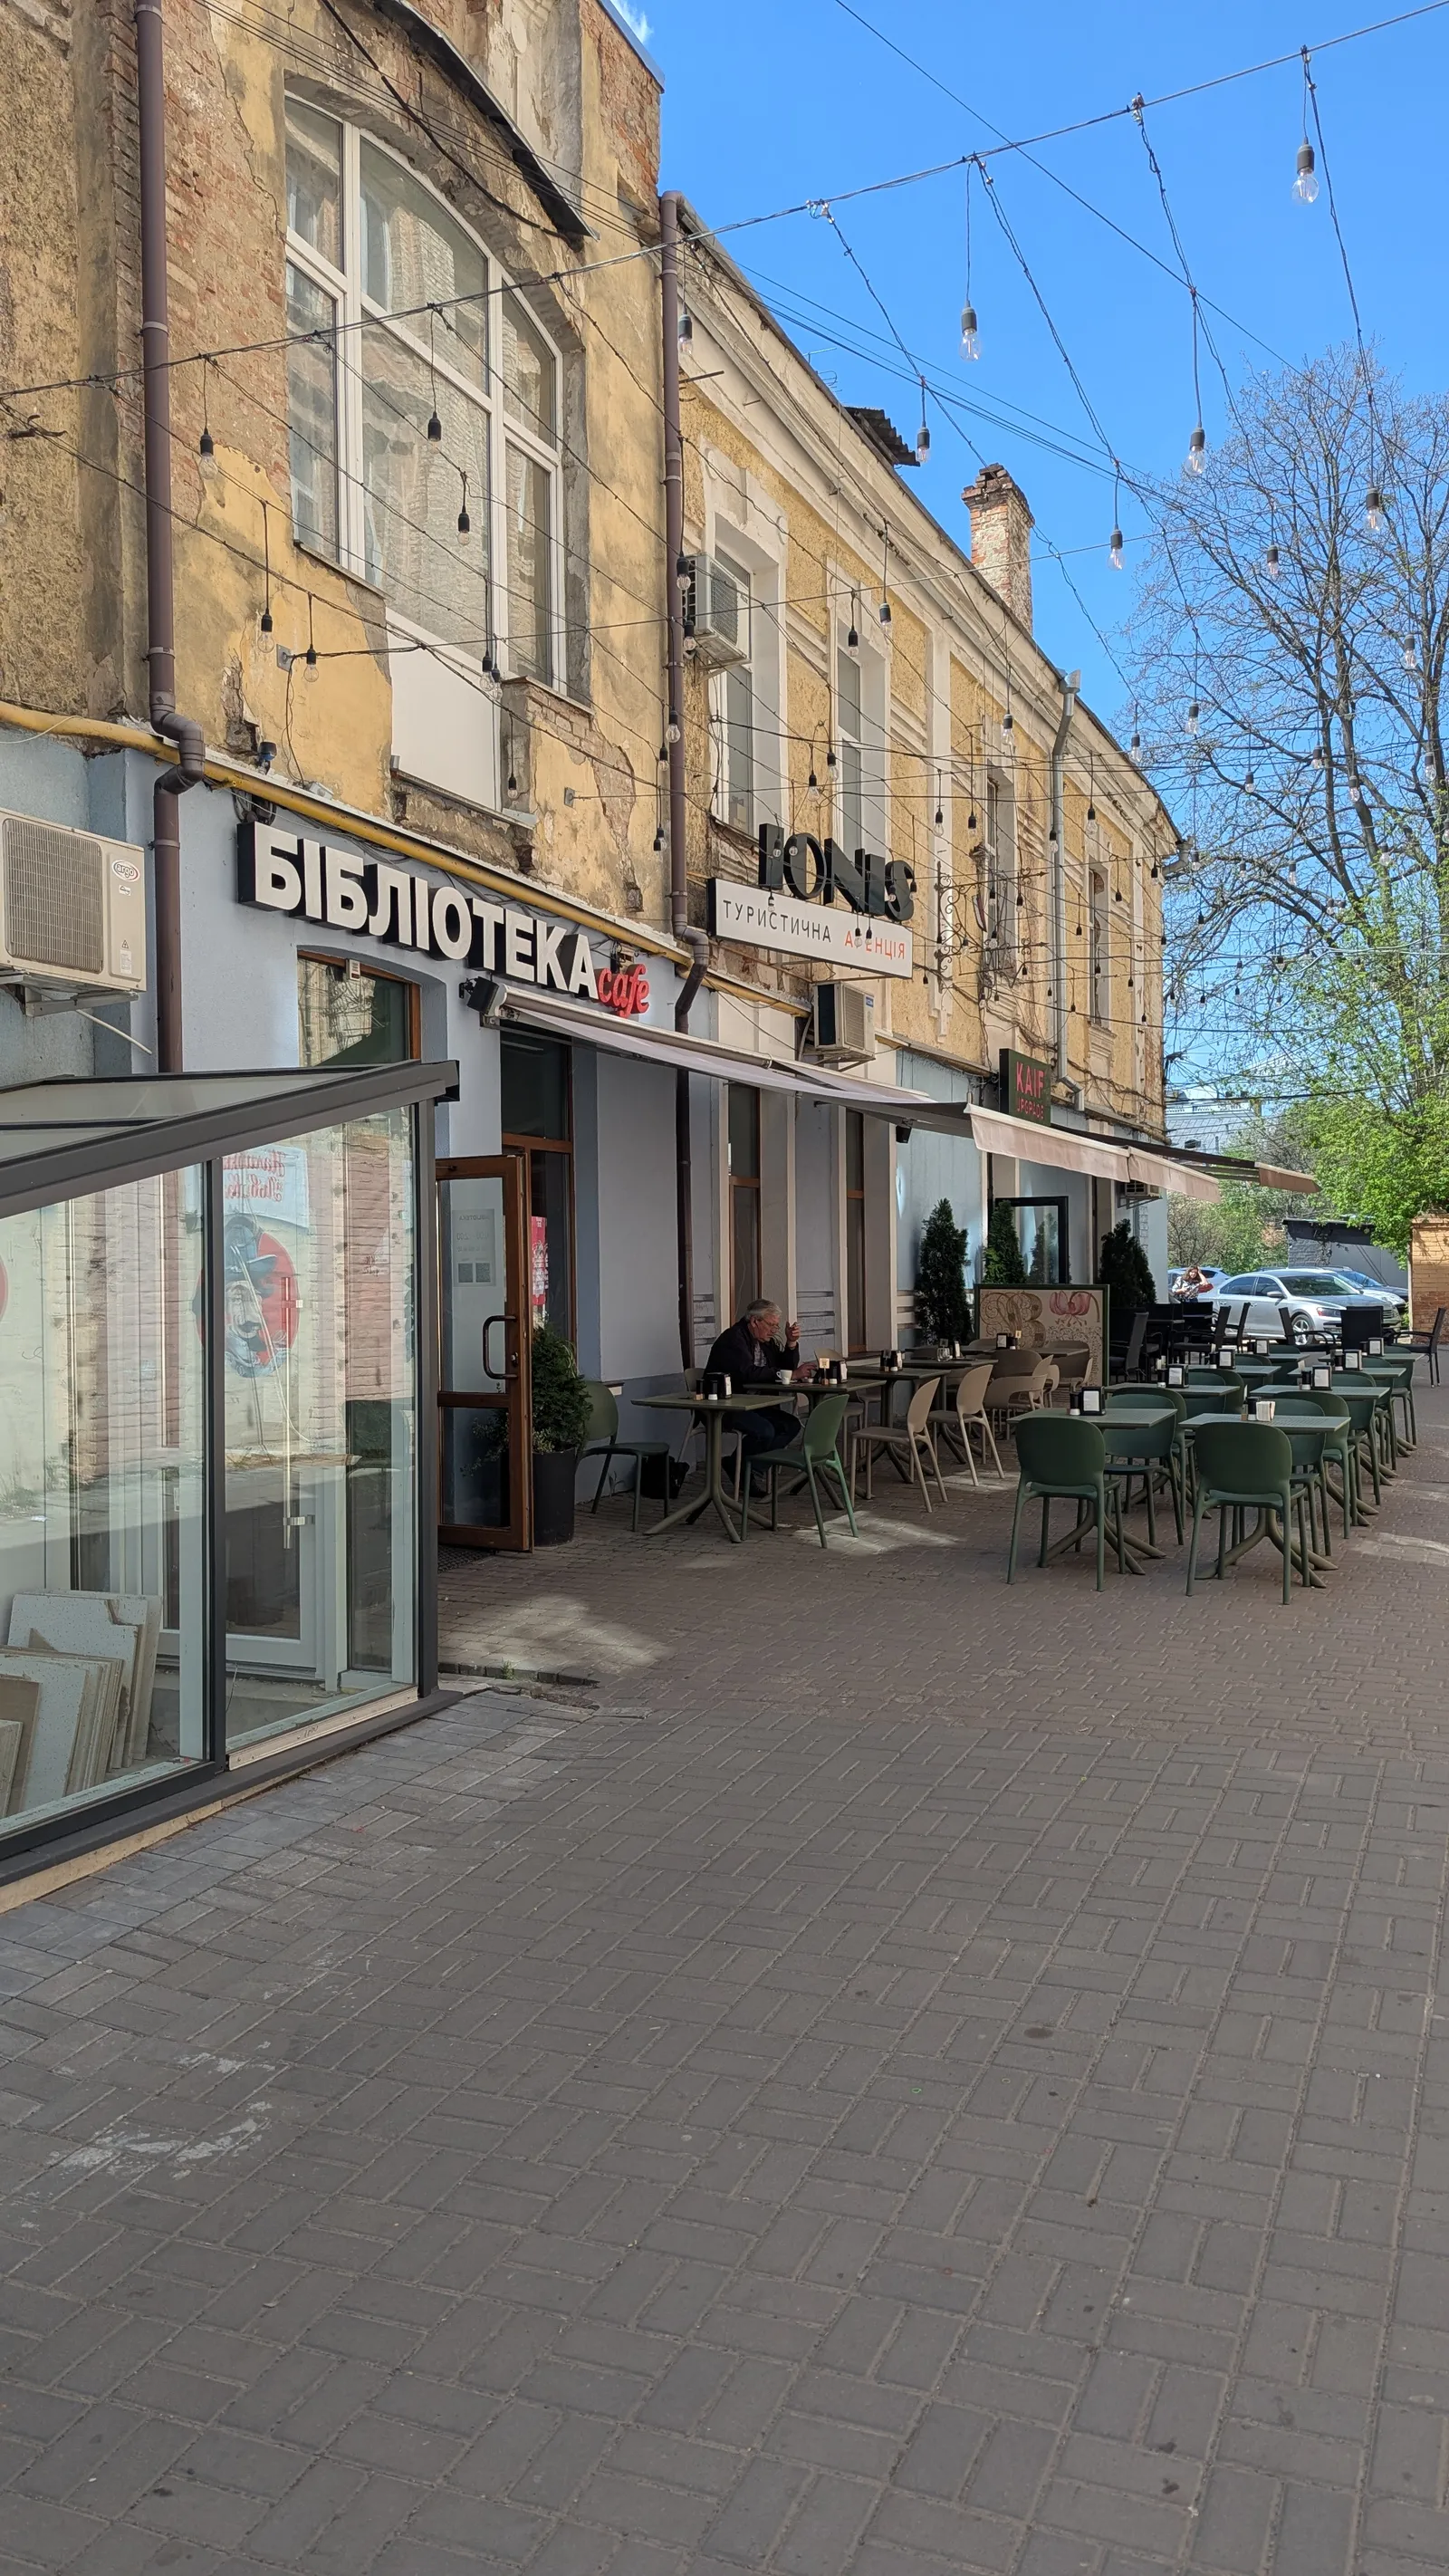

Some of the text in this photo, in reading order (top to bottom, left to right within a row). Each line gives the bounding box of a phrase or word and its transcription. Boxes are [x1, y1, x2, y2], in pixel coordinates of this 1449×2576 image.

[117, 863, 135, 879] argo
[759, 823, 915, 922] IONIS
[252, 821, 650, 1019] БІБЛІОТЕКА cafe
[723, 899, 906, 960] ТУРИСТИЧНА АЕНЦІЯ
[1016, 1061, 1045, 1099] KAIF
